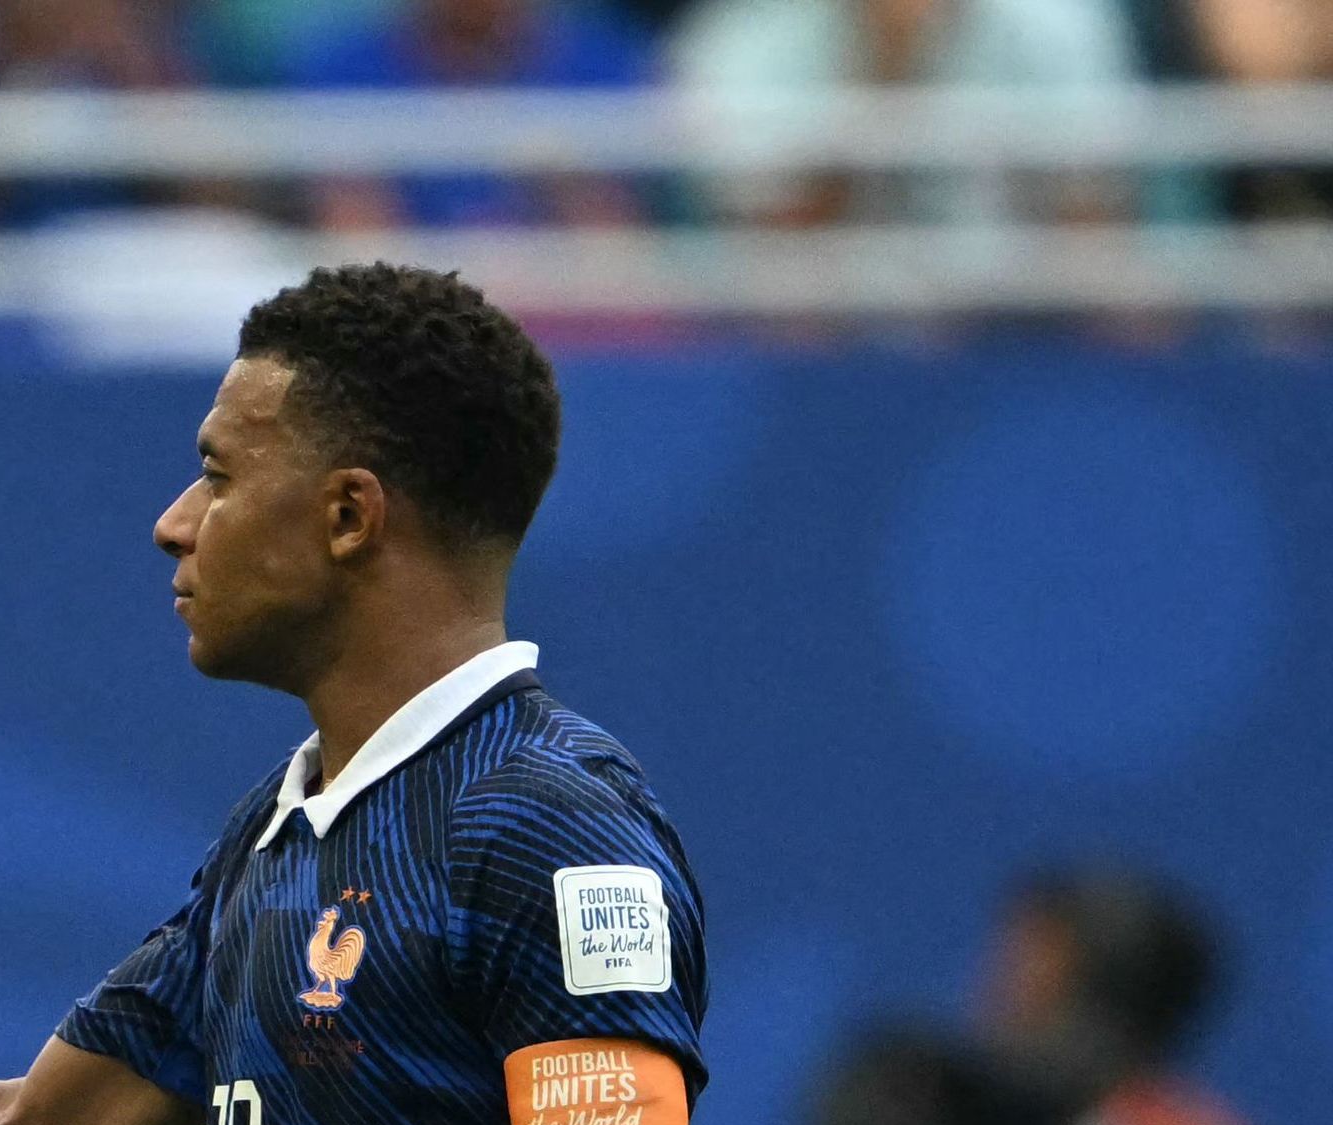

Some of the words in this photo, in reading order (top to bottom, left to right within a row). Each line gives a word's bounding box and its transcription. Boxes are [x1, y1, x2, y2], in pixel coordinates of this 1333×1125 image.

[578, 887, 648, 906] FOOTBALL
[580, 906, 650, 932] UNITES
[579, 934, 608, 957] the
[610, 931, 654, 956] World
[605, 958, 633, 969] FIFA
[532, 1051, 634, 1080] FOOTBALL
[533, 1073, 637, 1111] UNITES
